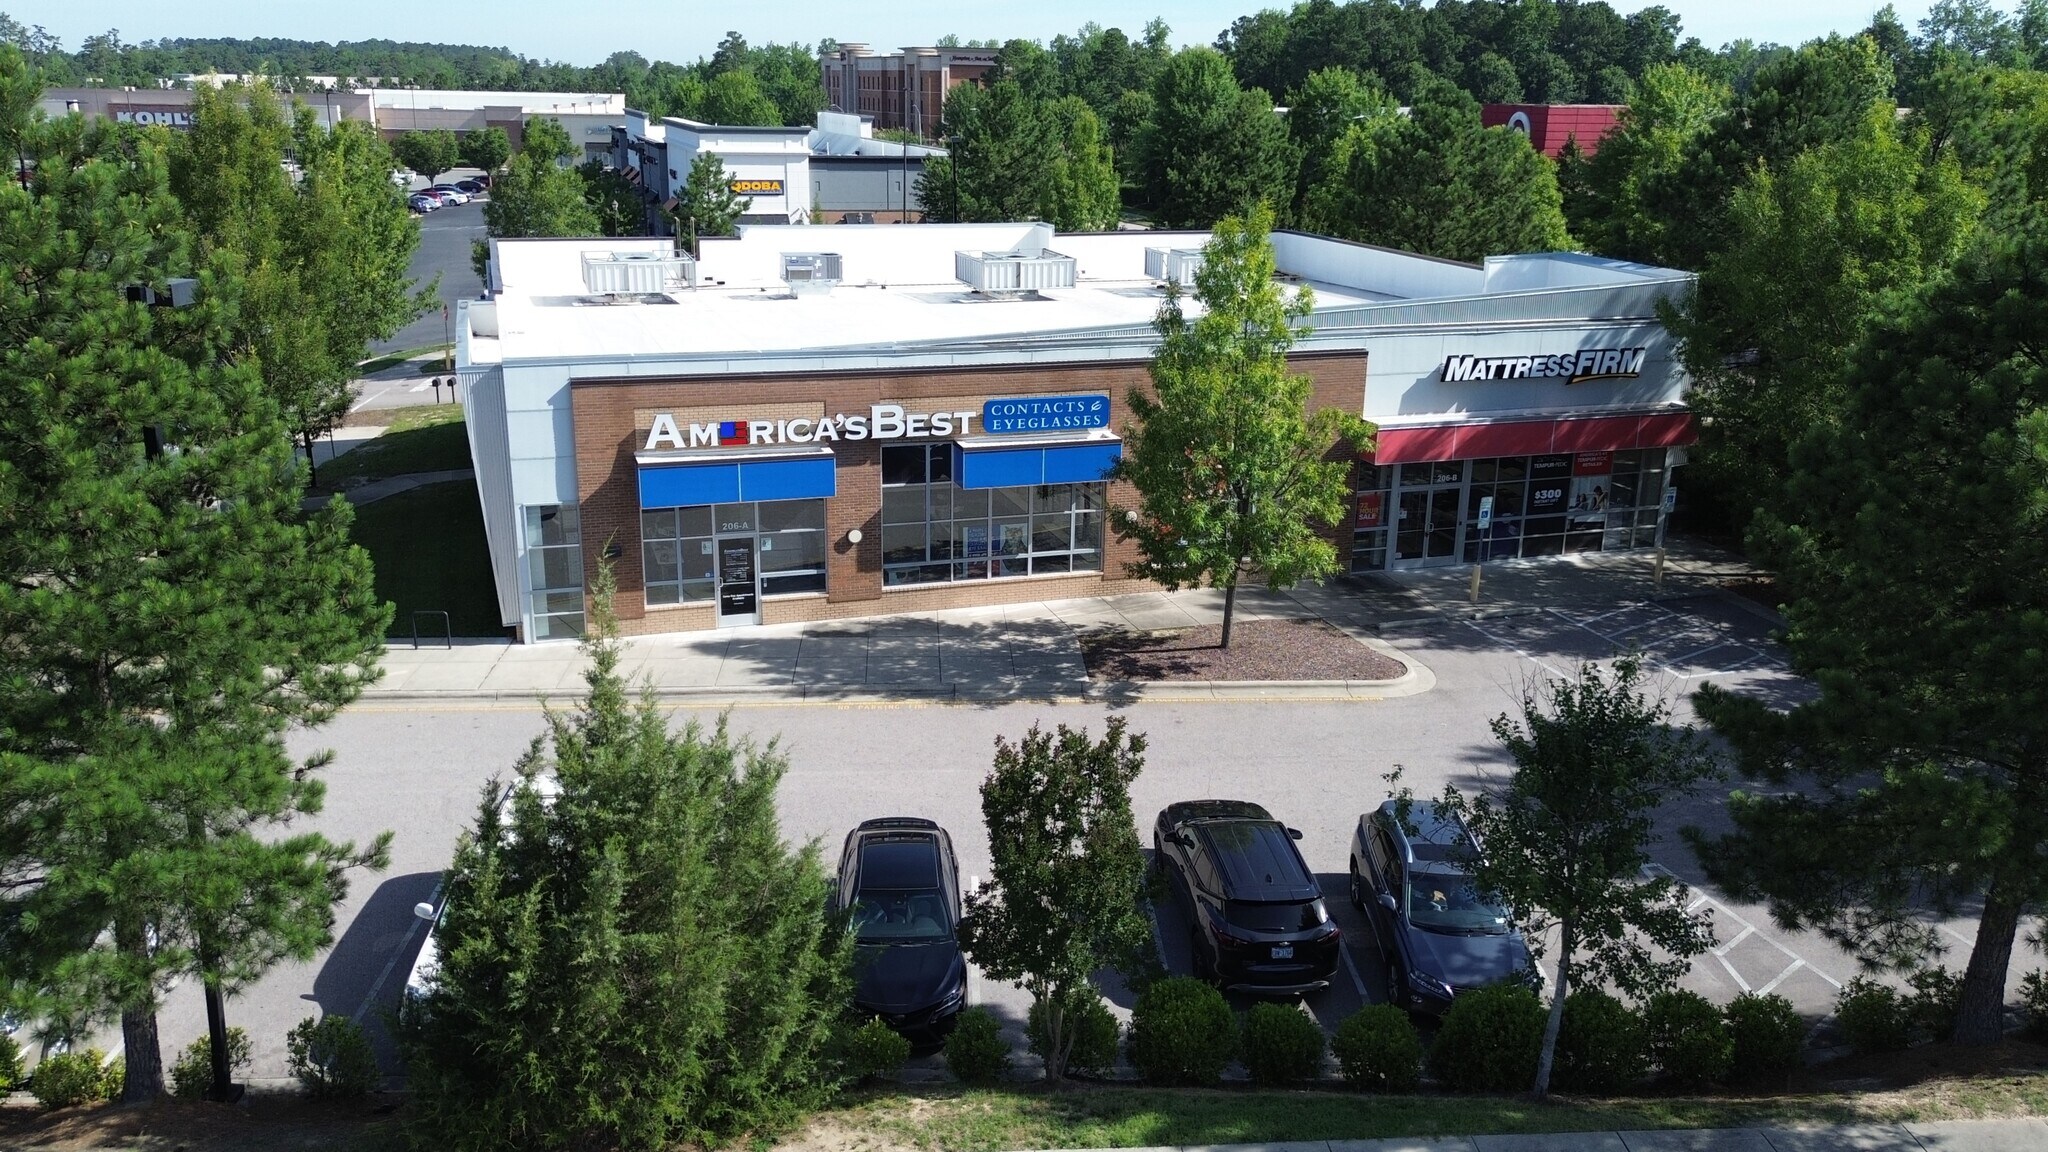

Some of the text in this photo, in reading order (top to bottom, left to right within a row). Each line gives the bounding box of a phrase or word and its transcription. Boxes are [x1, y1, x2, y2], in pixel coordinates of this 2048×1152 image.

[730, 181, 781, 192] QDOBA
[990, 401, 1086, 416] CONTACTS
[870, 404, 977, 439] BEST
[992, 414, 1102, 431] EYEGLASSES
[1436, 474, 1458, 482] 206-B
[1534, 489, 1562, 500] $300
[722, 521, 749, 531] 206-A
